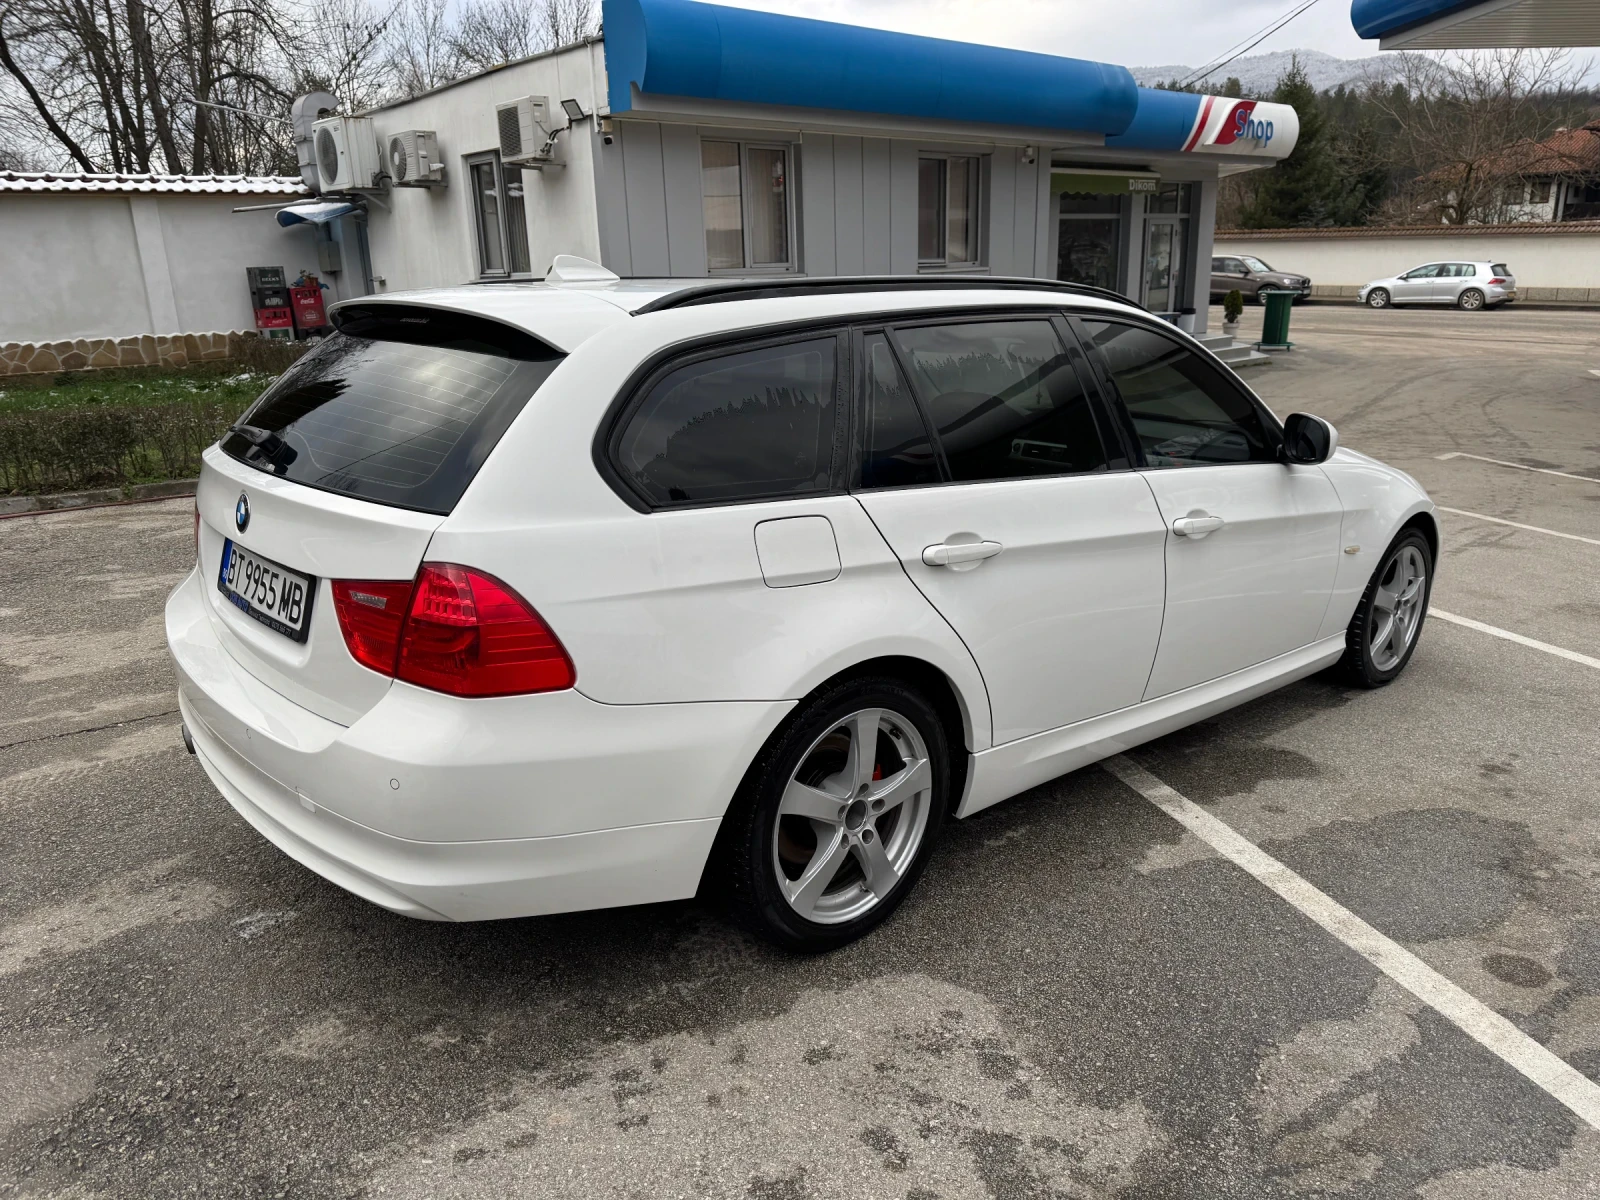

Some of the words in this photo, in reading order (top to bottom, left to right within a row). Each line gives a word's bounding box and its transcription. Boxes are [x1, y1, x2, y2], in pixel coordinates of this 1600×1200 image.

[1234, 108, 1274, 148] Shop
[1129, 179, 1156, 191] Dikom
[228, 549, 245, 589] BT
[244, 560, 279, 610] 9955
[278, 577, 303, 624] MB
